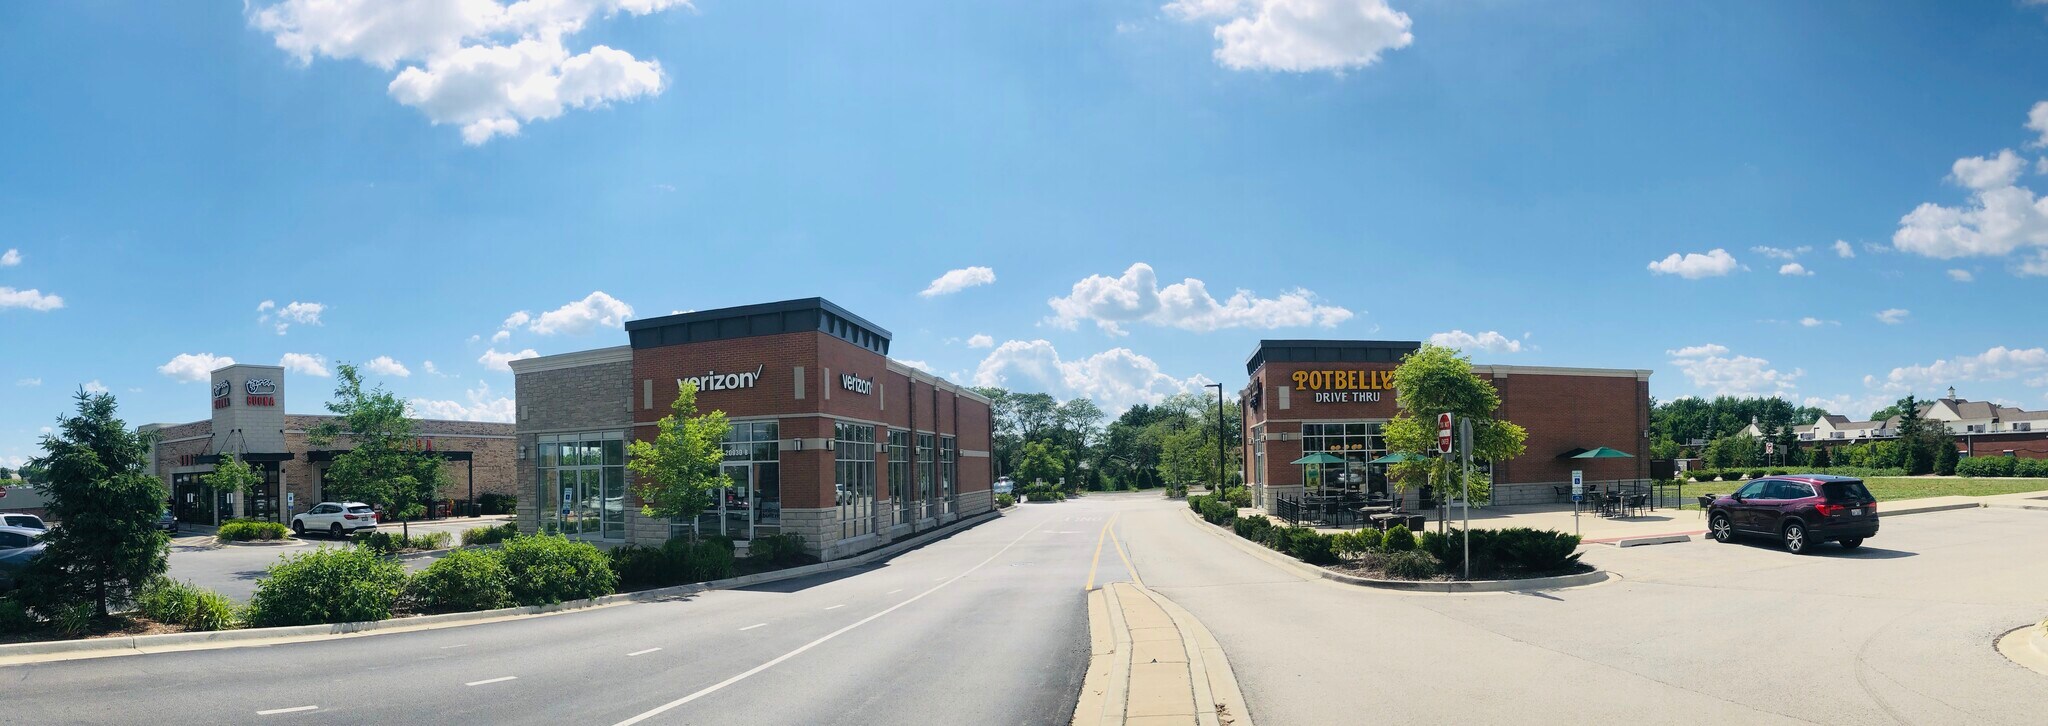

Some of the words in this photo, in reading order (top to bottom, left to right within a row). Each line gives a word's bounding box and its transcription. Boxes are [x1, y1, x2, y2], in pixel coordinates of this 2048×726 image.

[677, 371, 753, 392] verizon
[842, 372, 872, 396] verizon
[1292, 370, 1394, 391] POTBELLY
[1315, 392, 1348, 403] DRIVE
[1352, 392, 1380, 402] THRU
